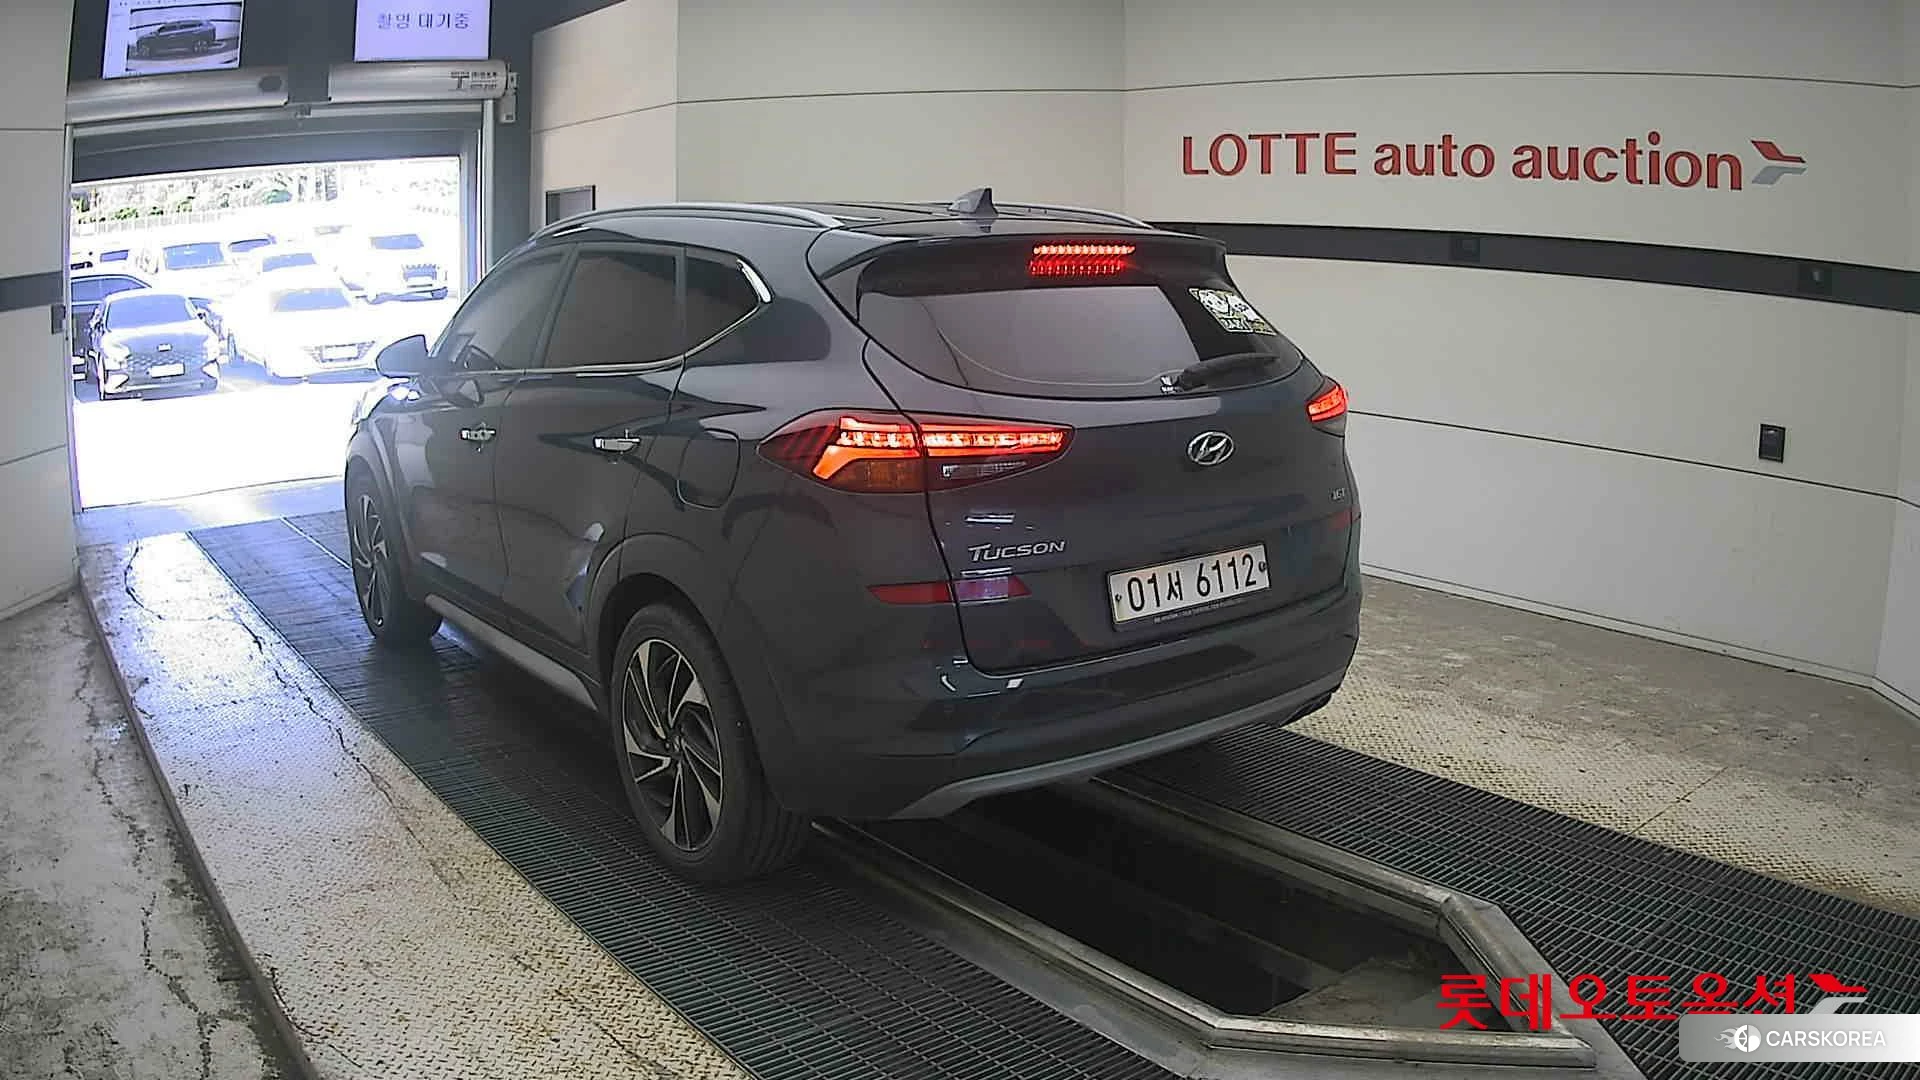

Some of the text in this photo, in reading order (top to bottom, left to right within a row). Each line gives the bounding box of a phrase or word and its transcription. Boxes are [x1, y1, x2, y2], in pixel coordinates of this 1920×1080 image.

[418, 13, 469, 29] 대기중
[1182, 131, 1742, 190] LOTTE auto auction
[968, 540, 1065, 562] TUCSON
[1128, 570, 1183, 612] 01서
[1196, 553, 1257, 597] 6112
